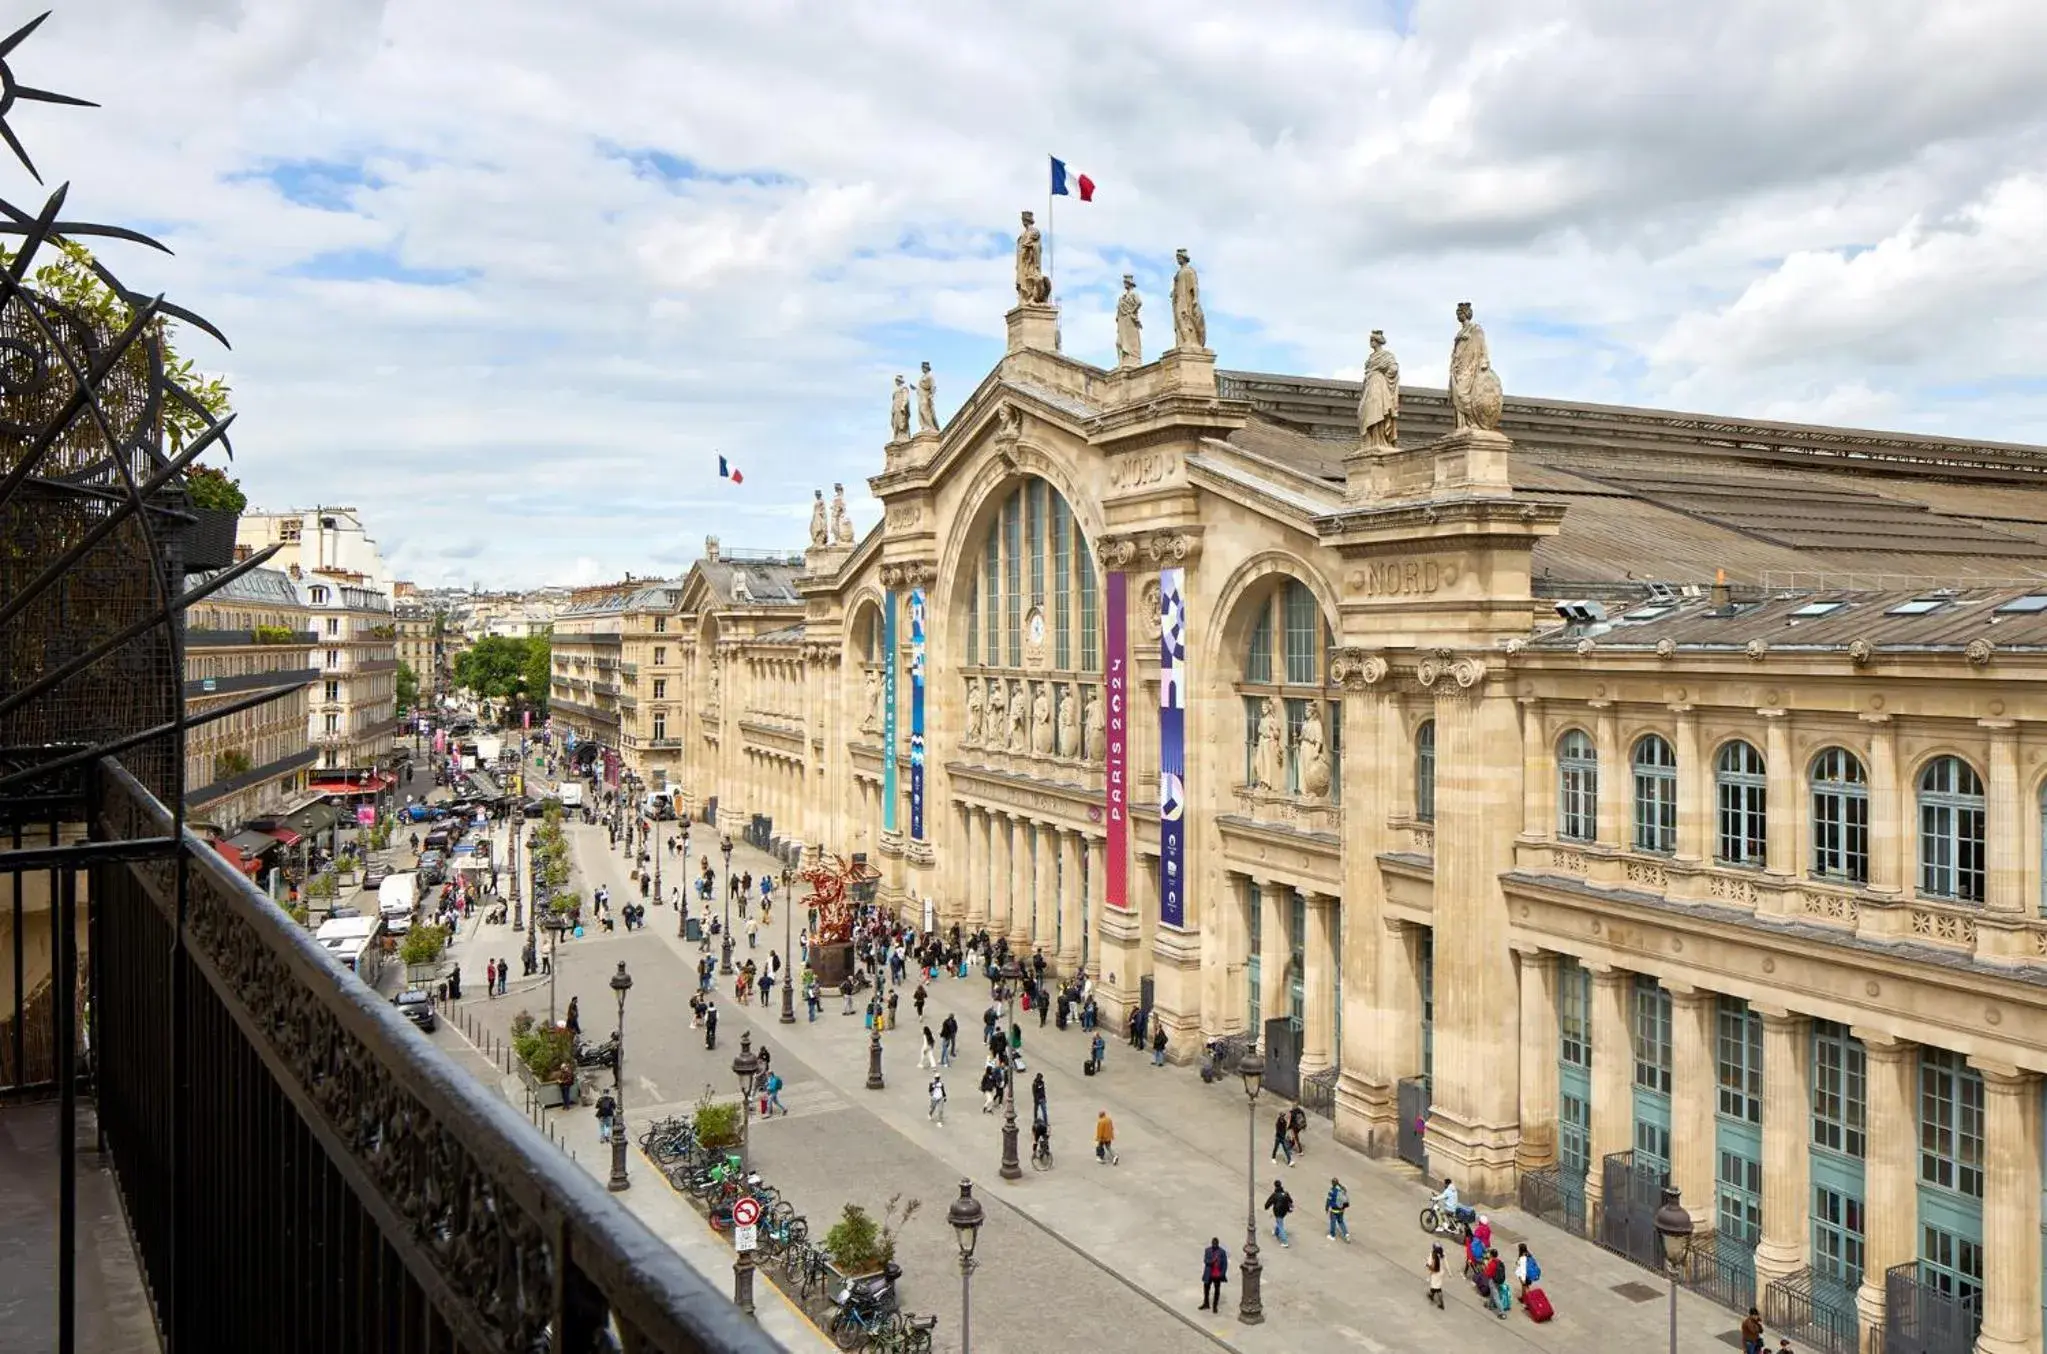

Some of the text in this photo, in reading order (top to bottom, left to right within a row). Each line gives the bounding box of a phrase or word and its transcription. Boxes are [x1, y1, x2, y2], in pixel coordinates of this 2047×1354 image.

[1367, 560, 1439, 596] NORD
[1111, 659, 1122, 821] PARIS 2024
